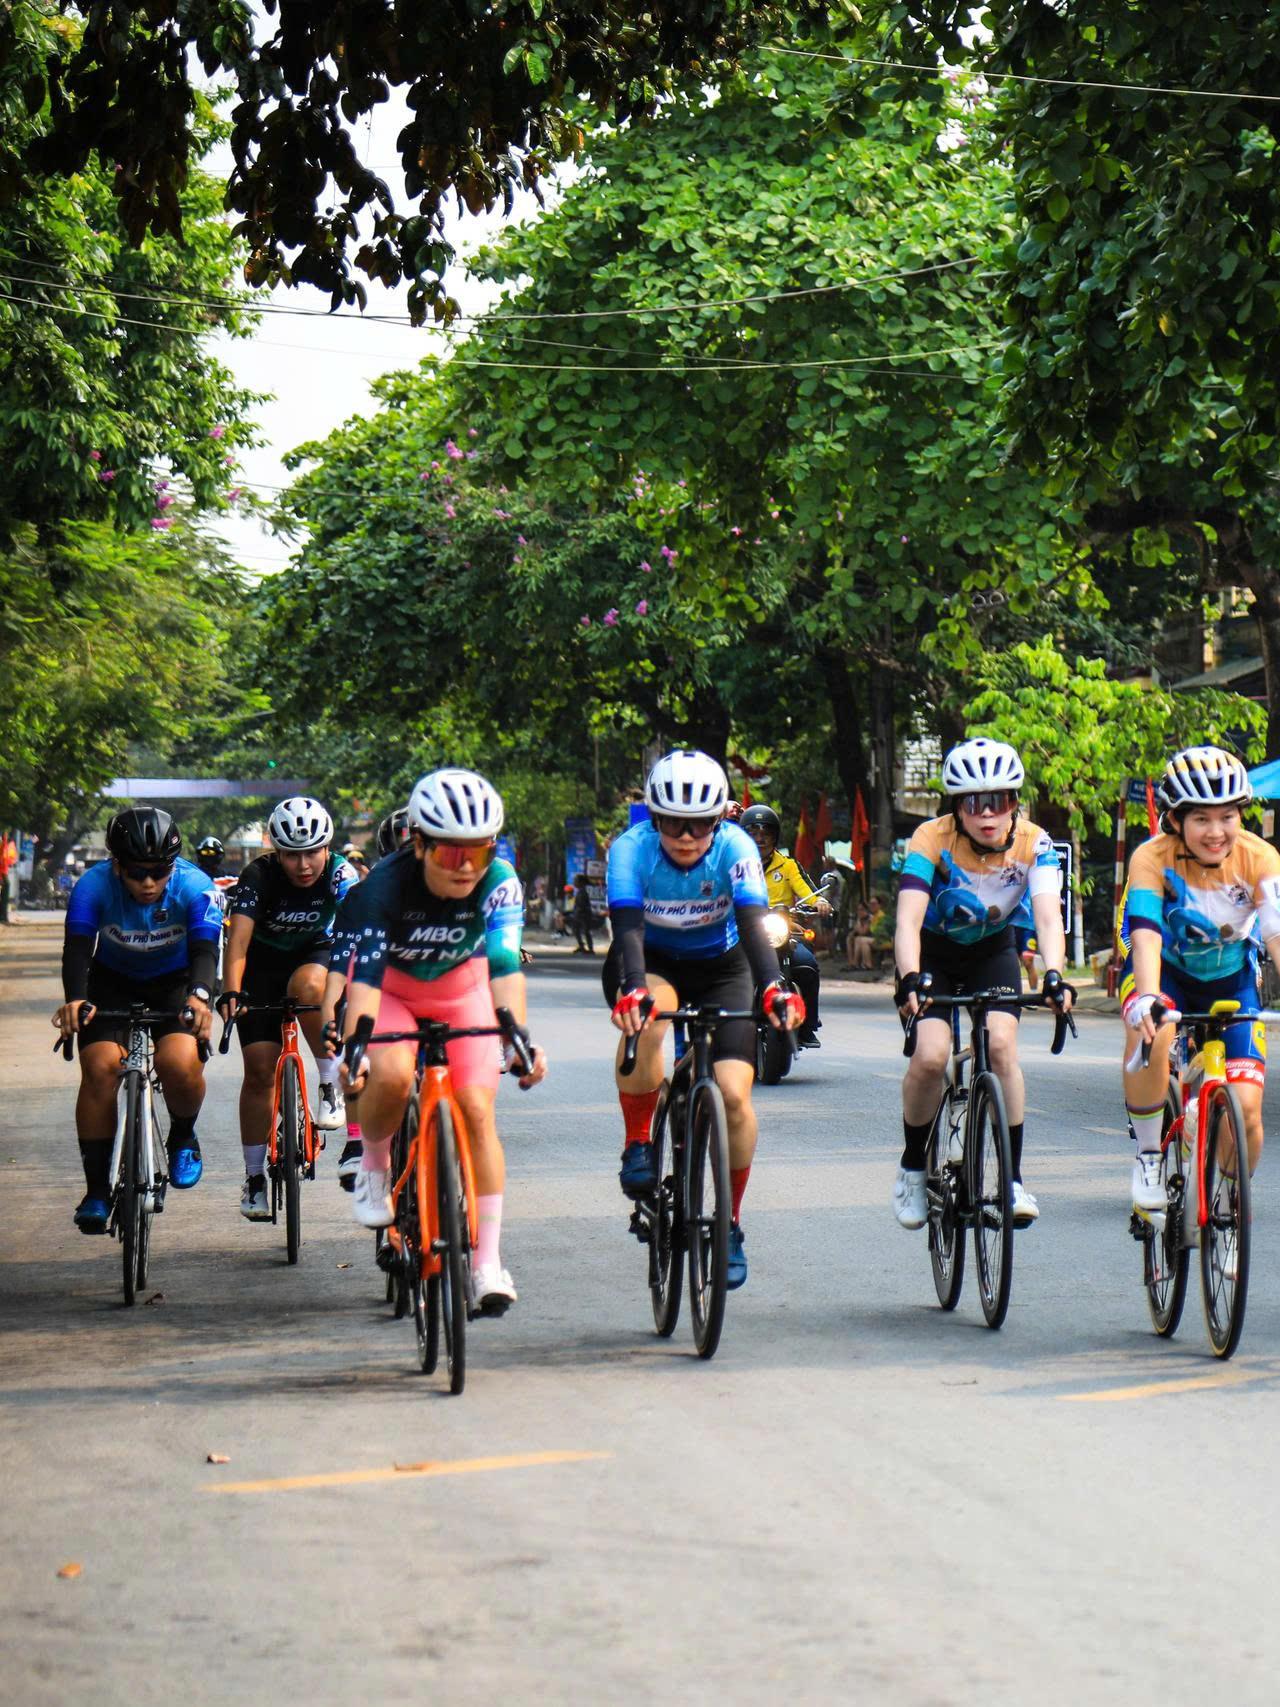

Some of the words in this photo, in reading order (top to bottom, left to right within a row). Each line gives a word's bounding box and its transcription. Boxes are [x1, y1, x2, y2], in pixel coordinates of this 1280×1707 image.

[276, 911, 321, 923] MBO
[409, 927, 467, 943] MBO
[390, 943, 433, 961] VIET
